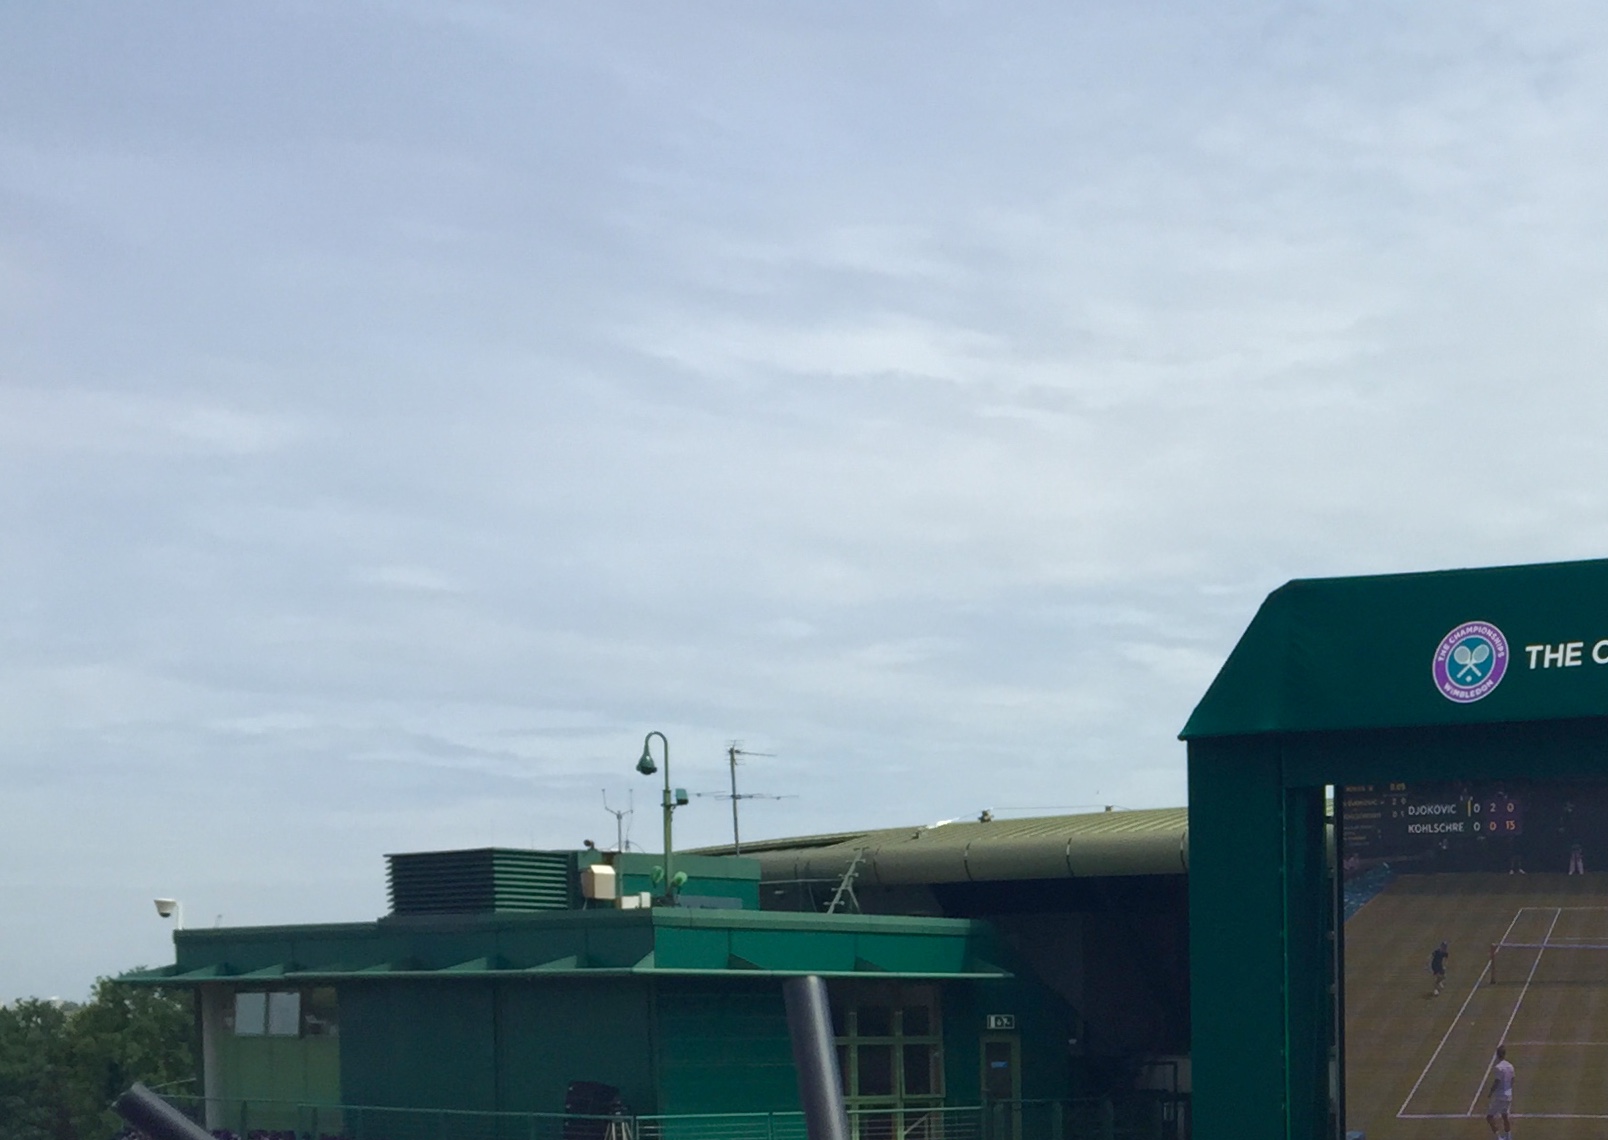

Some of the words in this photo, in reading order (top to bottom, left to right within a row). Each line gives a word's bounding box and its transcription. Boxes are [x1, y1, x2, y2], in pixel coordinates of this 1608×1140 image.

[1437, 643, 1451, 662] THE
[1448, 625, 1505, 658] CHAMPIONSHIPS
[1525, 641, 1584, 669] THE
[1443, 679, 1494, 699] WIMBLEDON
[1408, 804, 1456, 815] DJOKOVIC
[1473, 803, 1480, 813] 0
[1490, 803, 1496, 812] 2
[1507, 802, 1514, 812] 0
[1408, 822, 1464, 833] KOHLSCHRE
[1473, 822, 1480, 831] 0
[1489, 821, 1497, 831] 0
[1505, 820, 1516, 830] 15
